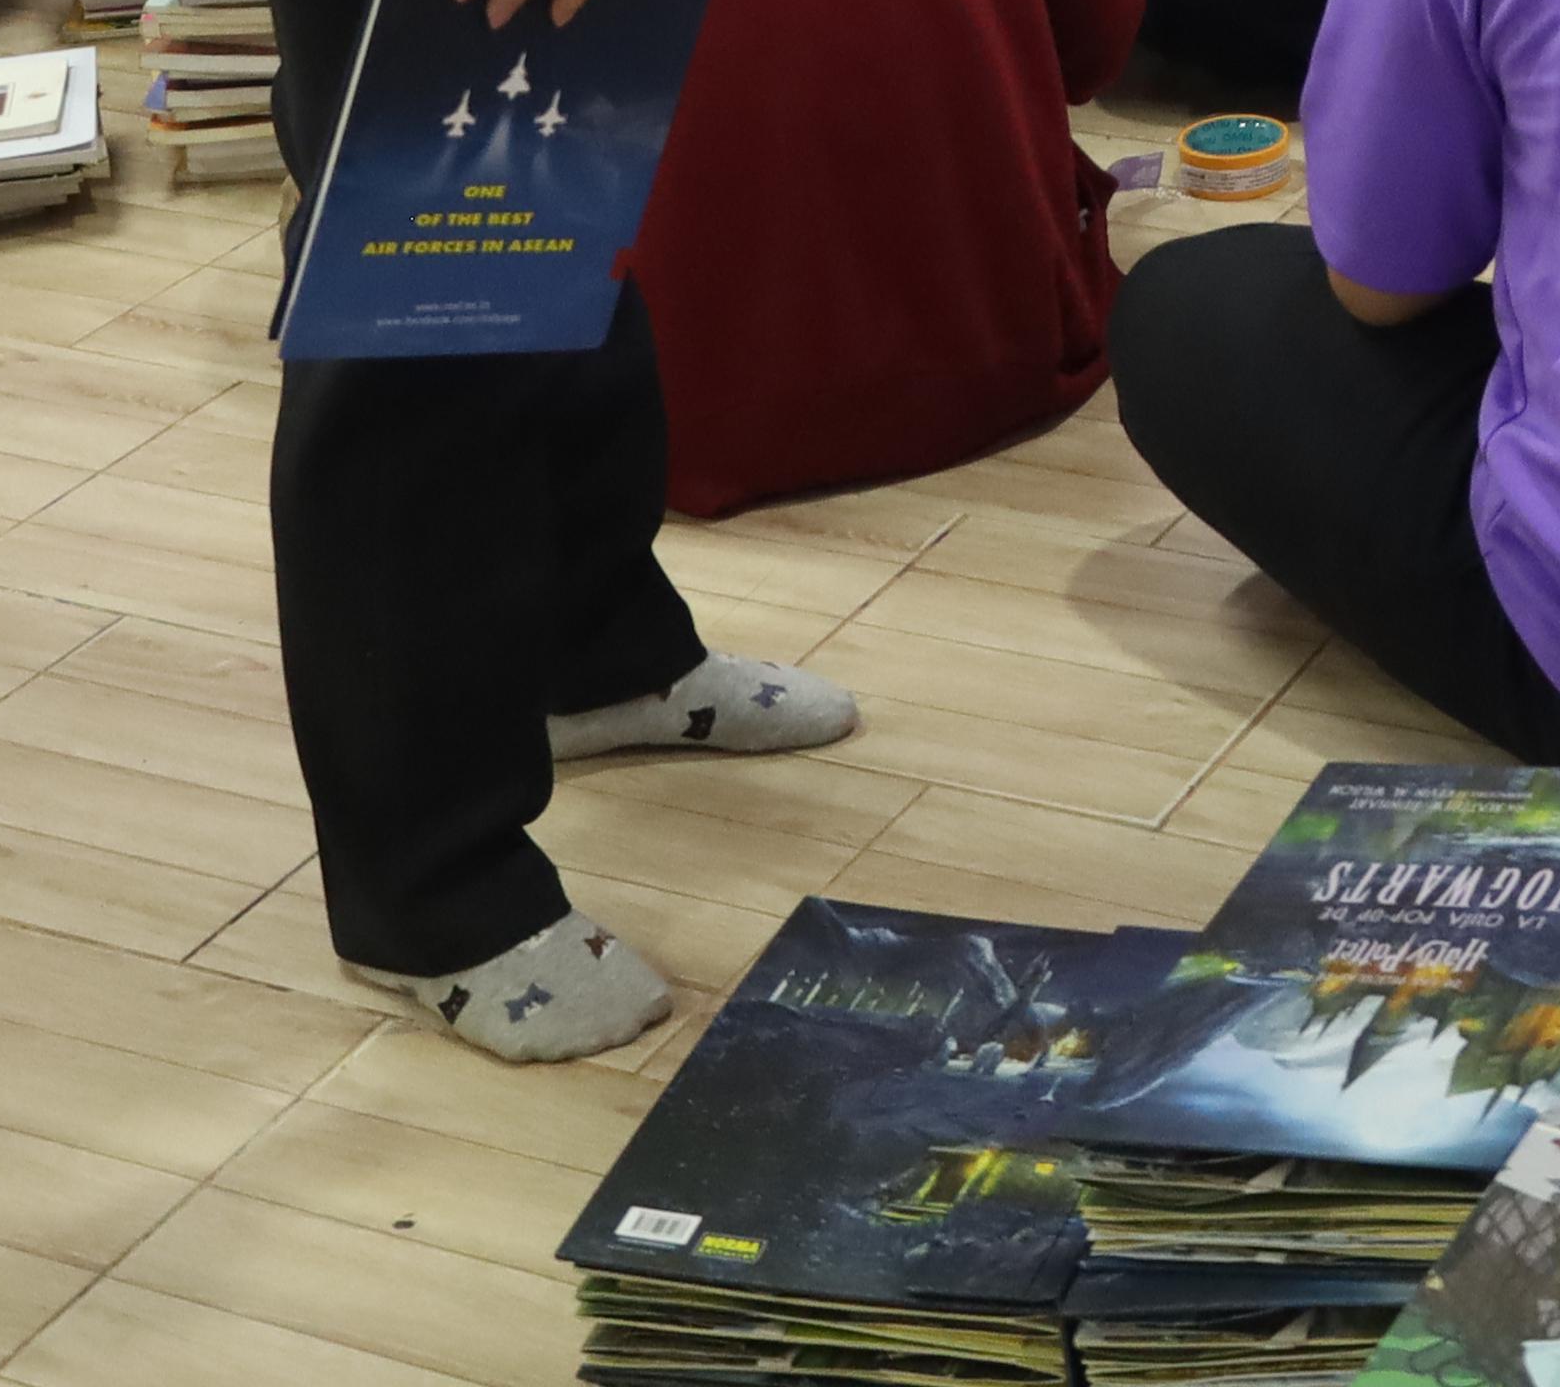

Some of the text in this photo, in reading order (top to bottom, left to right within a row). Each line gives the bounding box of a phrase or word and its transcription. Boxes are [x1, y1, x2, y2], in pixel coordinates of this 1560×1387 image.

[464, 185, 507, 199] ONE
[415, 212, 534, 226] OF THE BEST
[362, 238, 574, 256] AIR FORCES IN ASEAN
[1317, 906, 1349, 921] DE
[1518, 915, 1547, 930] LA
[1326, 932, 1490, 973] Harry Potter
[702, 1236, 760, 1253] NORMA
